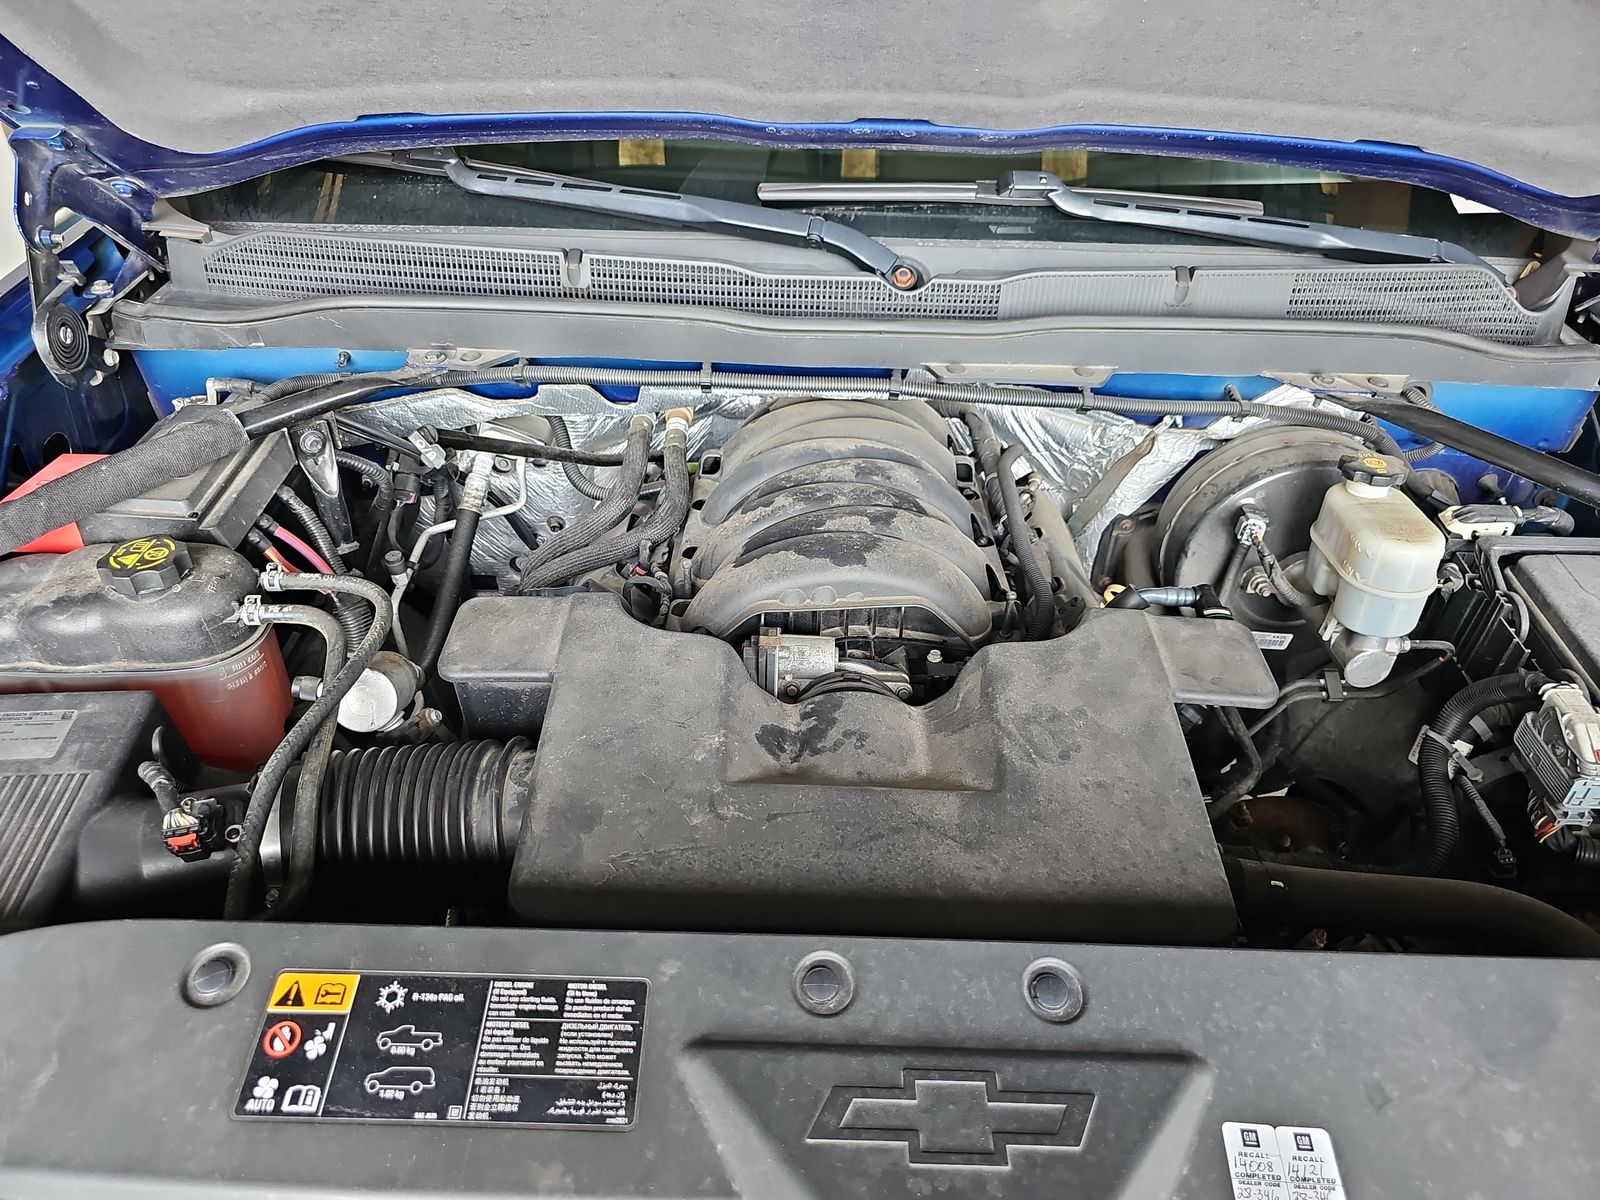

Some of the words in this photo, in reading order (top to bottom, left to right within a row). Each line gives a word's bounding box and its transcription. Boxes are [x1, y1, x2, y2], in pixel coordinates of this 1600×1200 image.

[412, 992, 438, 1002] R-134a
[438, 993, 453, 1002] PAG
[406, 1046, 416, 1057] kg
[395, 1090, 404, 1101] kg
[244, 1098, 275, 1112] AUTO
[1234, 1156, 1273, 1173] 14008
[1235, 1172, 1281, 1180] COMPLETED
[1290, 1176, 1336, 1184] COMPLETED
